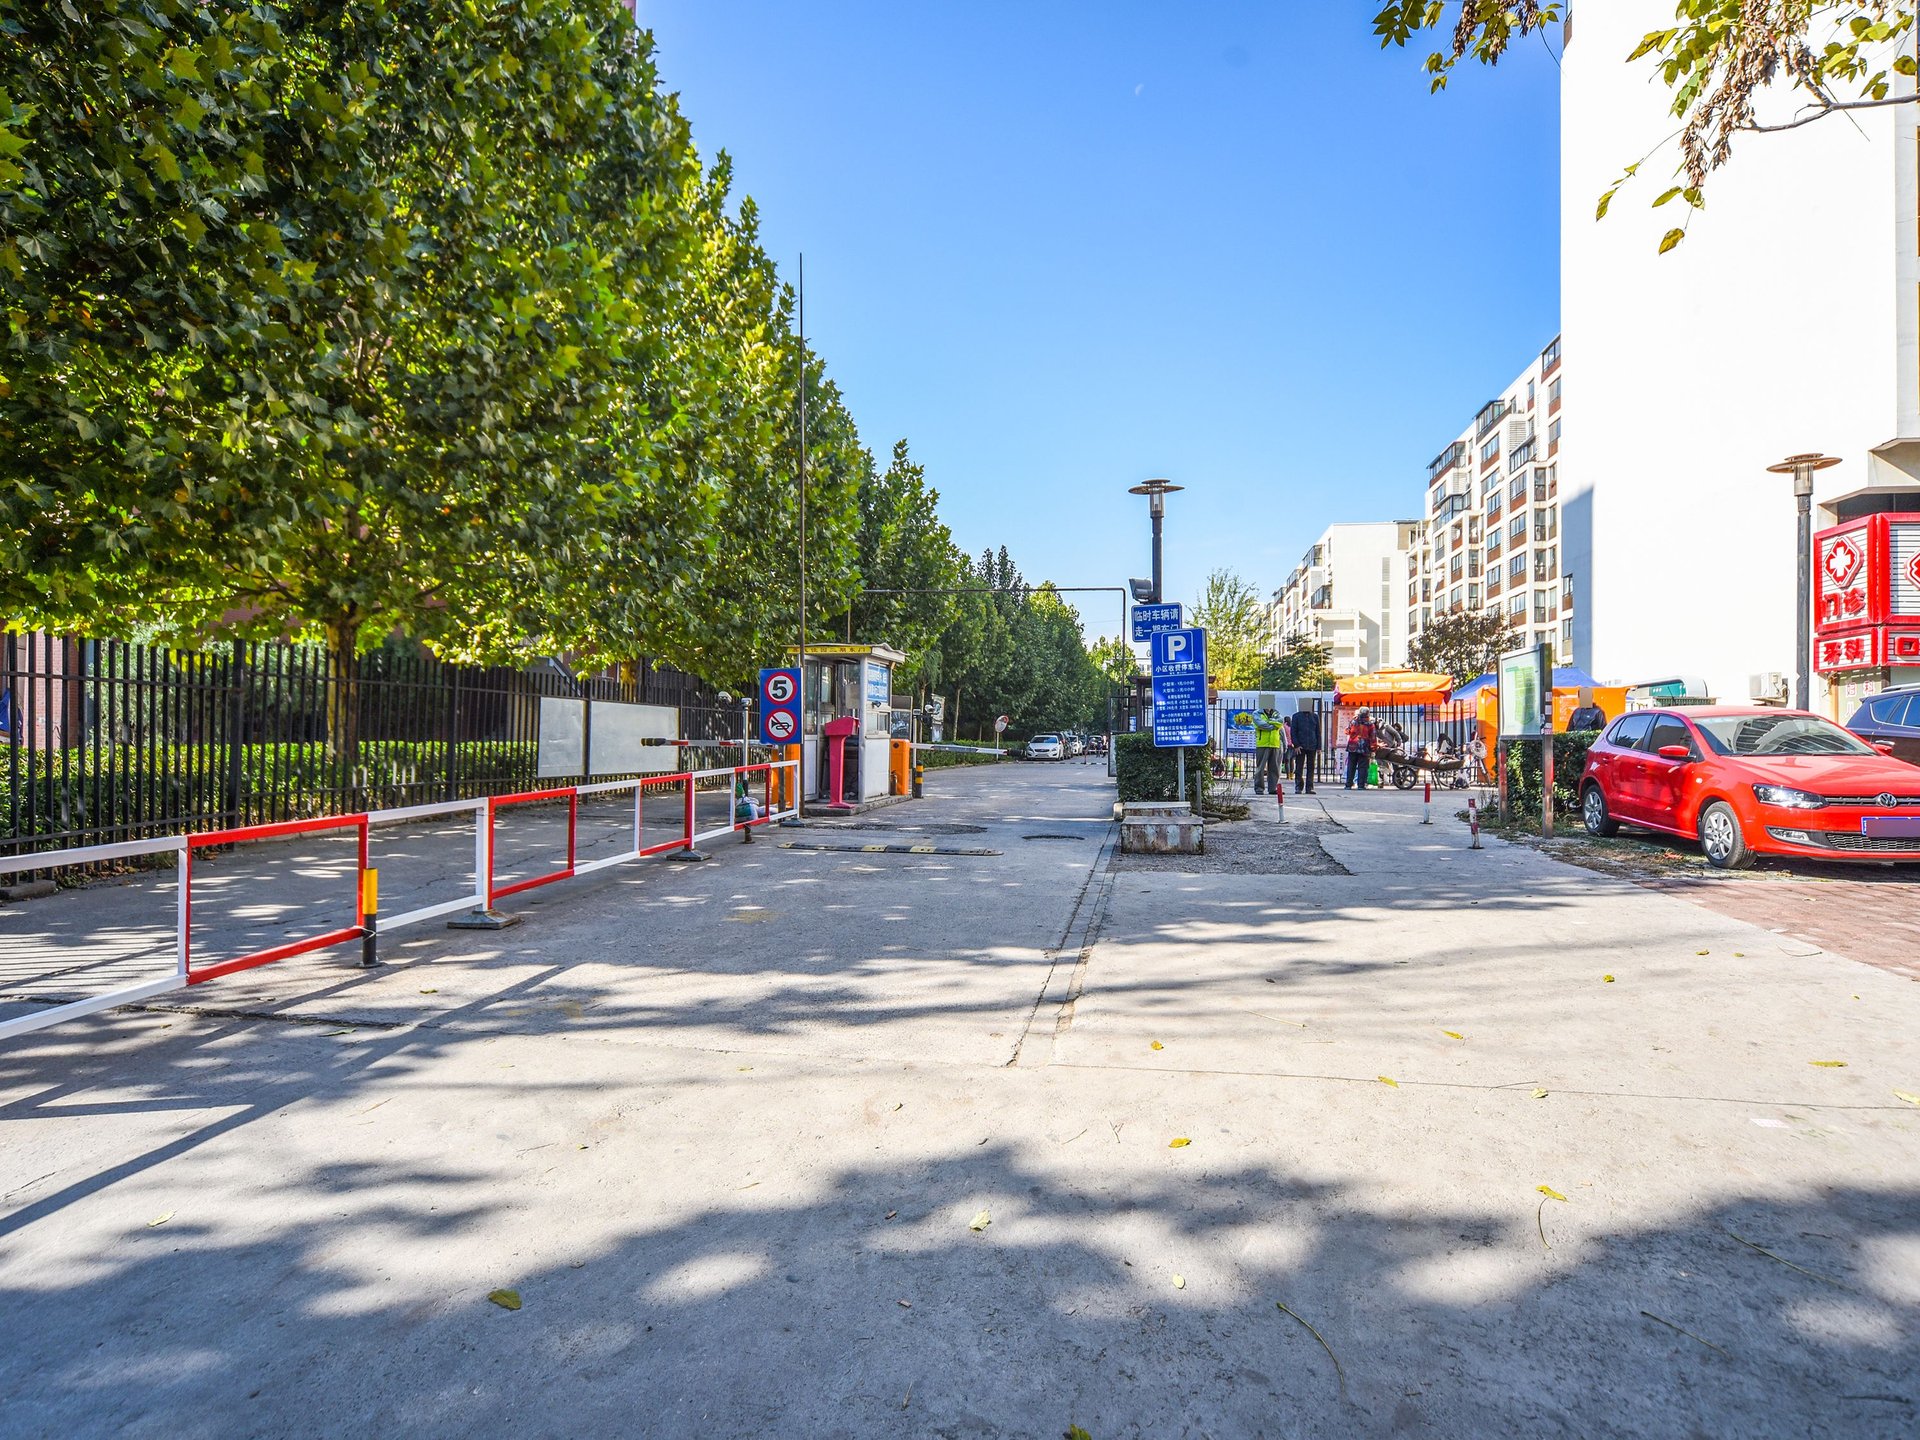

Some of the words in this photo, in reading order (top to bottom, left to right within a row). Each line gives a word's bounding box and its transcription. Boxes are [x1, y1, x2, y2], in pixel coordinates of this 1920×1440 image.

[1823, 588, 1866, 618] 门诊
[1134, 609, 1179, 622] 临时车辆请
[1167, 635, 1187, 661] P
[1823, 638, 1864, 664] 牙科
[1155, 663, 1201, 674] 小区收费停车场
[772, 679, 787, 699] 5
